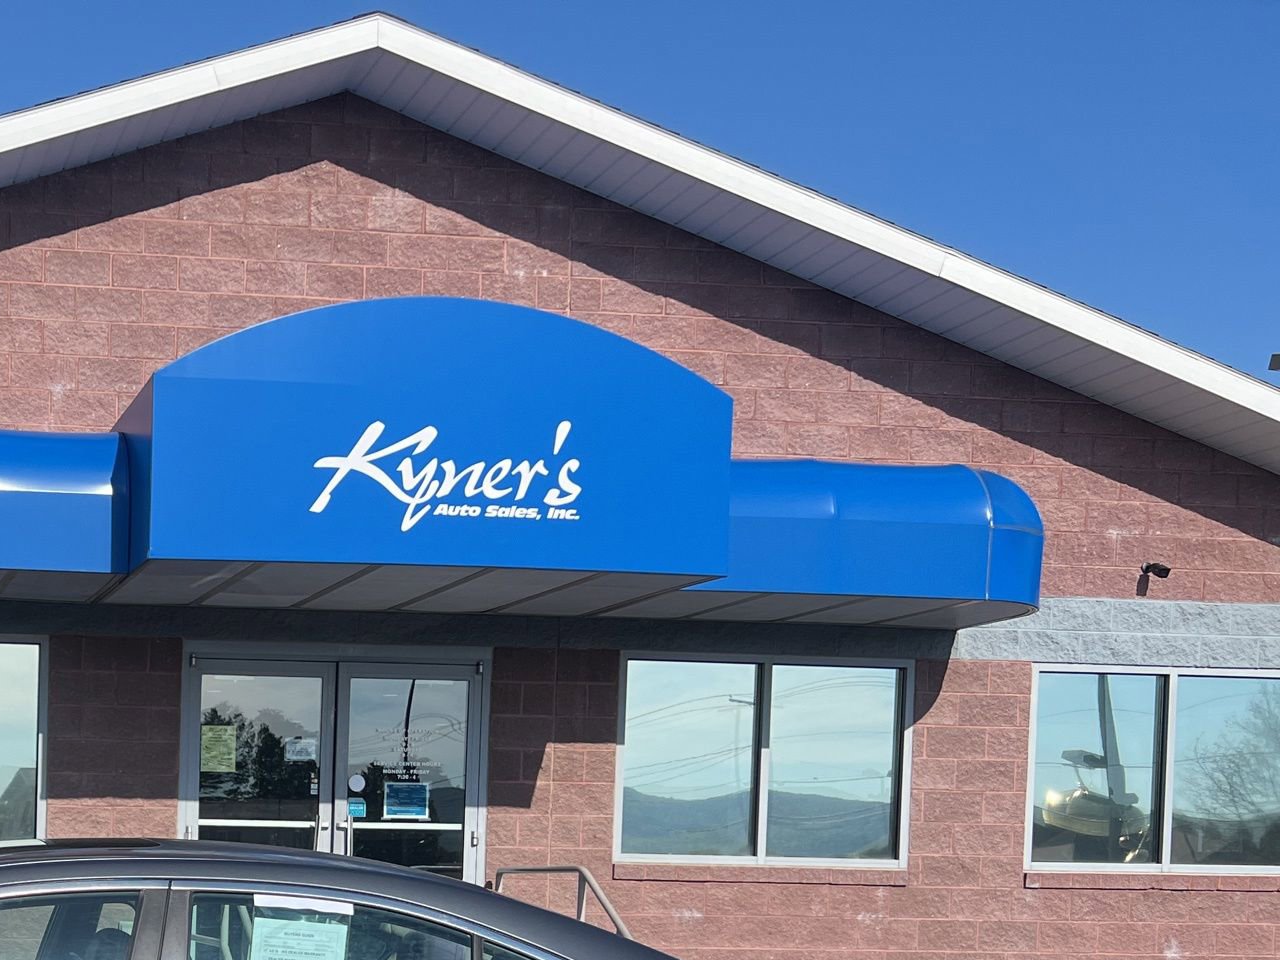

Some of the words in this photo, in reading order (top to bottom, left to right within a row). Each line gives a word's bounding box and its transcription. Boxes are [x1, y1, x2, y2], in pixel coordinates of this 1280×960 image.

[308, 420, 582, 532] Kyner's
[433, 502, 481, 517] Auto
[484, 504, 542, 520] Sales,
[547, 506, 581, 520] Inc.
